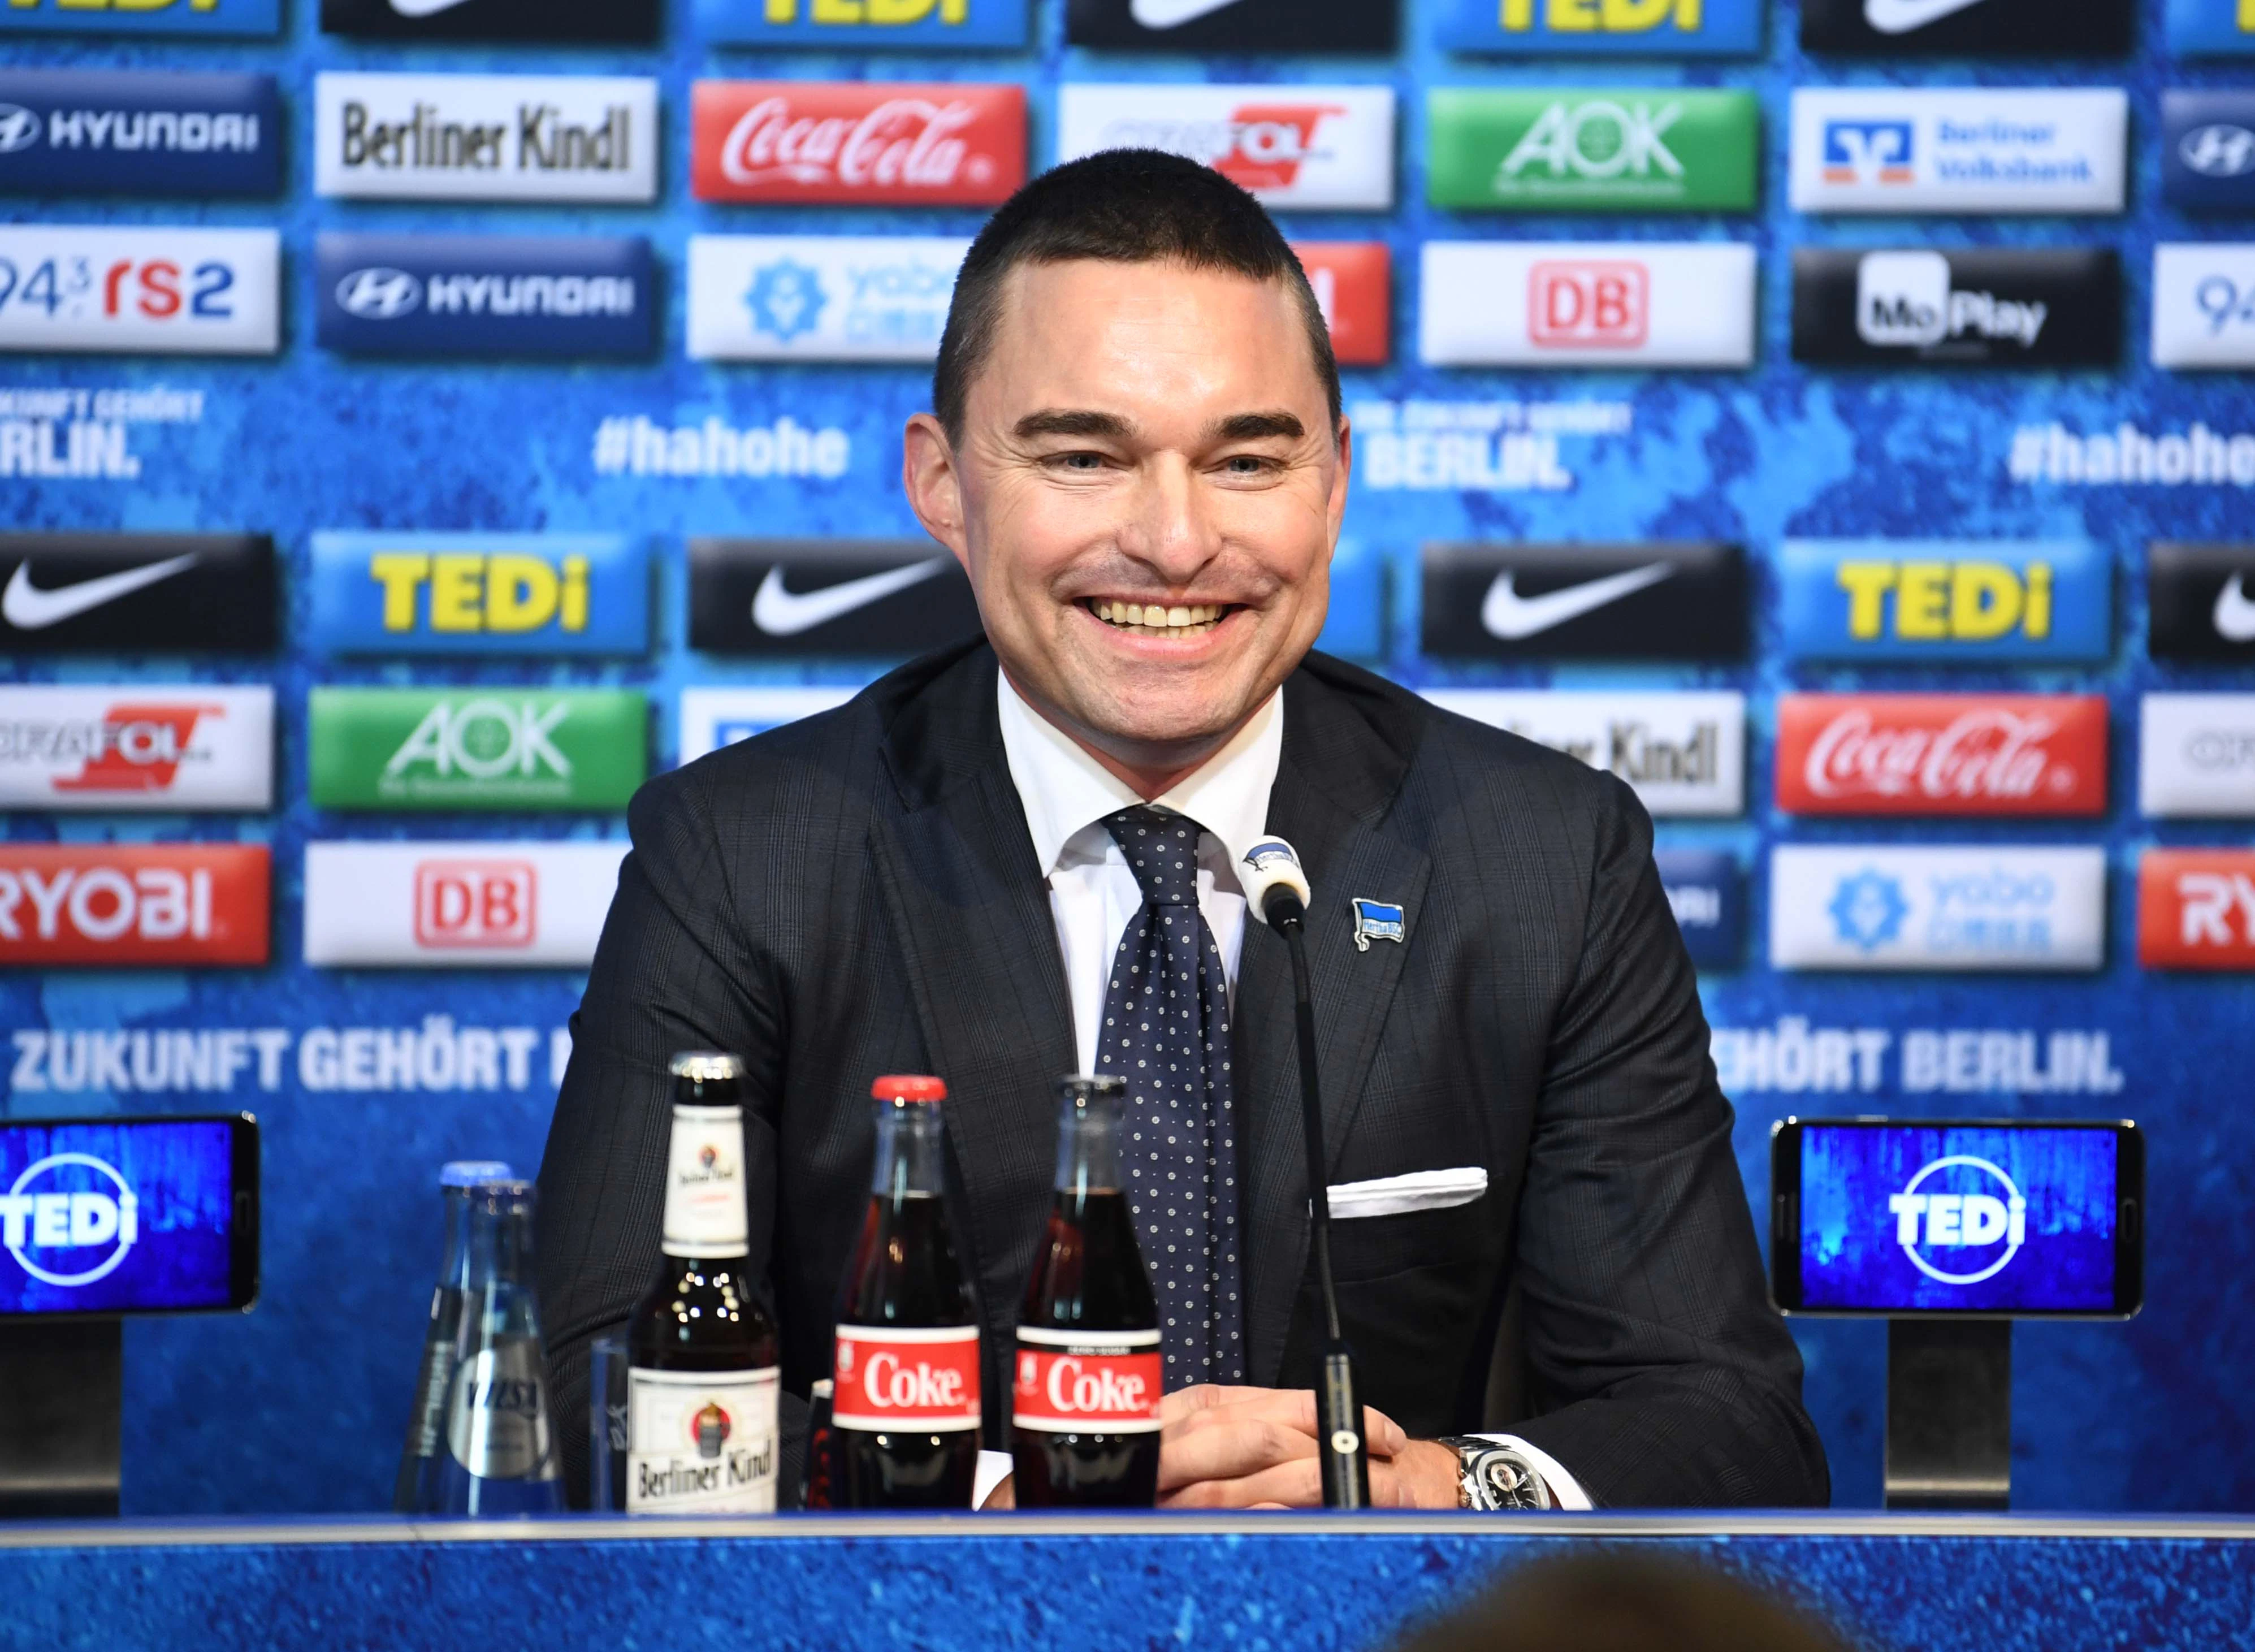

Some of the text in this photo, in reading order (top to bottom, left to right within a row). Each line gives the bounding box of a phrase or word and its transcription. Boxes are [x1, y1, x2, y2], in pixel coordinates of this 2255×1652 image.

[50, 111, 258, 152] HYUNDAI
[342, 103, 630, 171] Berliner Kindl
[1501, 101, 1685, 175] AOK
[103, 258, 235, 319] rs2
[427, 275, 634, 317] HYUNDAI
[1546, 276, 1632, 331] DB
[592, 416, 850, 479] #hahohe
[370, 552, 590, 632] TEDi
[1837, 559, 2052, 640] TEDi
[387, 698, 571, 777] AOK
[1610, 719, 1719, 784] Kindl
[432, 877, 520, 931] DB
[10, 1028, 291, 1092] ZUKUNFT
[298, 1013, 539, 1092] GEHÖRT
[1708, 1014, 2125, 1095] EHÖRT BERLIN.
[0, 1192, 137, 1246] TEDi
[1889, 1193, 2026, 1246] TEDi
[863, 1352, 967, 1408] Coke
[1047, 1356, 1150, 1412] Coke
[638, 1458, 721, 1499] Berliner
